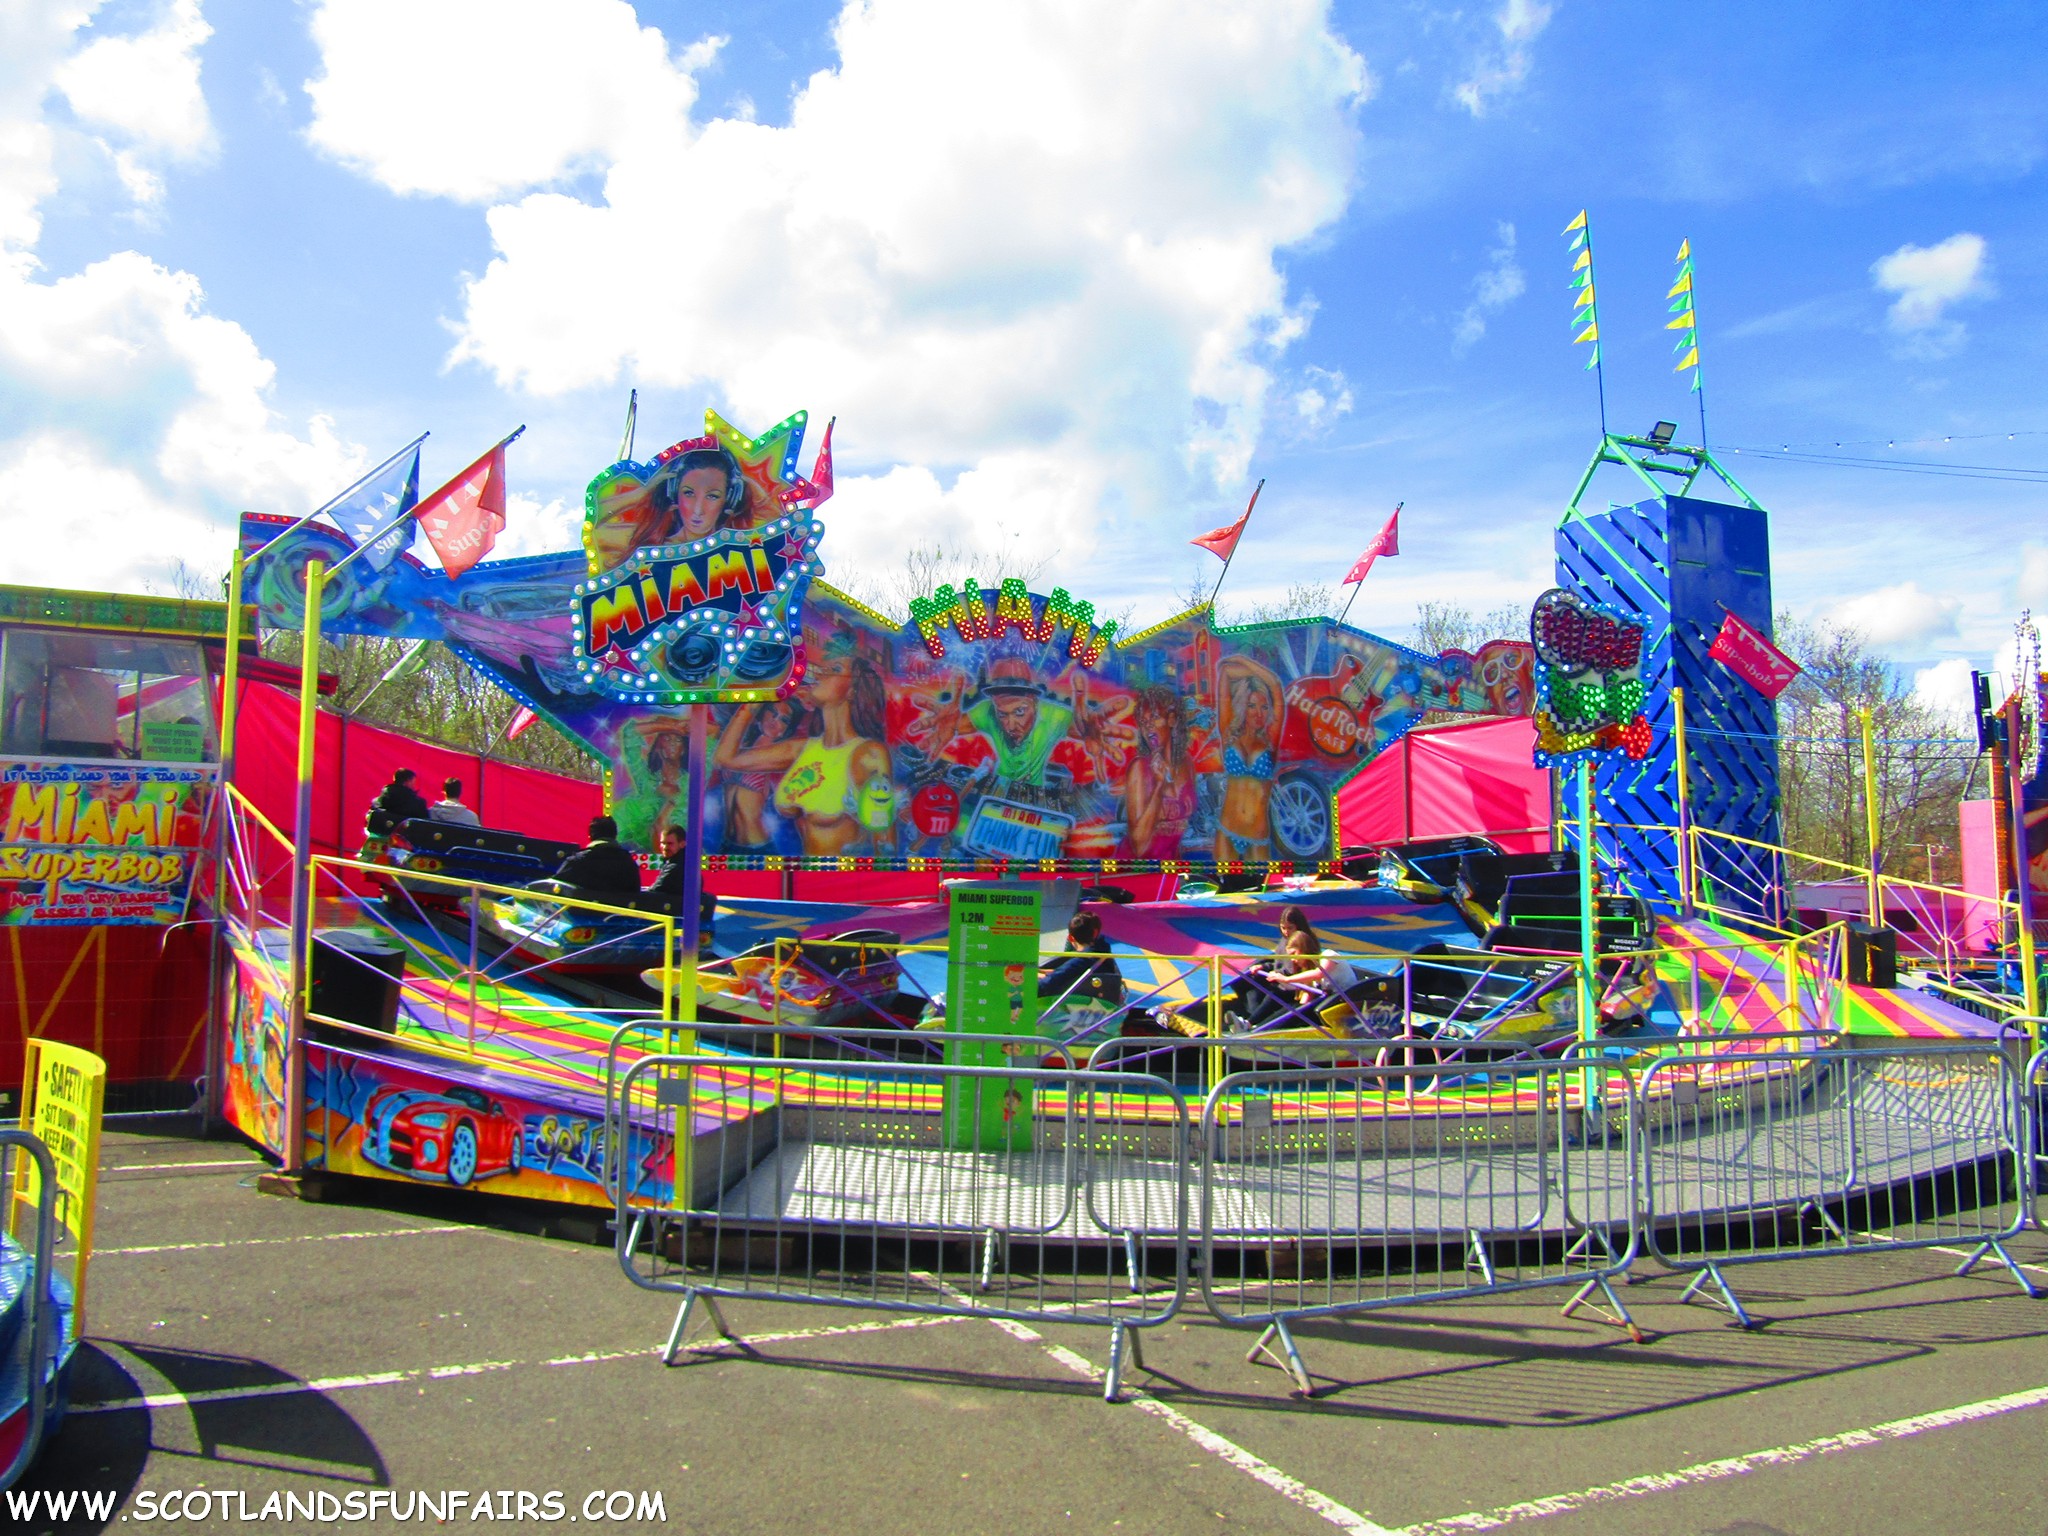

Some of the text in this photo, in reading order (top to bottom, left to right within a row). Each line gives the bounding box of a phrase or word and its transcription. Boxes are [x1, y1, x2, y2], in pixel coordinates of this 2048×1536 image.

[590, 547, 776, 653] MIAMI
[909, 577, 1118, 668] MIAMI
[1285, 685, 1376, 751] Hard Rock
[1313, 727, 1347, 751] CAFE
[153, 771, 176, 782] TOO
[179, 771, 202, 782] OLD
[1001, 805, 1043, 827] MIAMI
[0, 849, 183, 905] SUPERBOB
[9, 892, 44, 908] NOT
[958, 893, 1034, 906] MIAMI SUPERBOB
[961, 911, 984, 923] 1.2M
